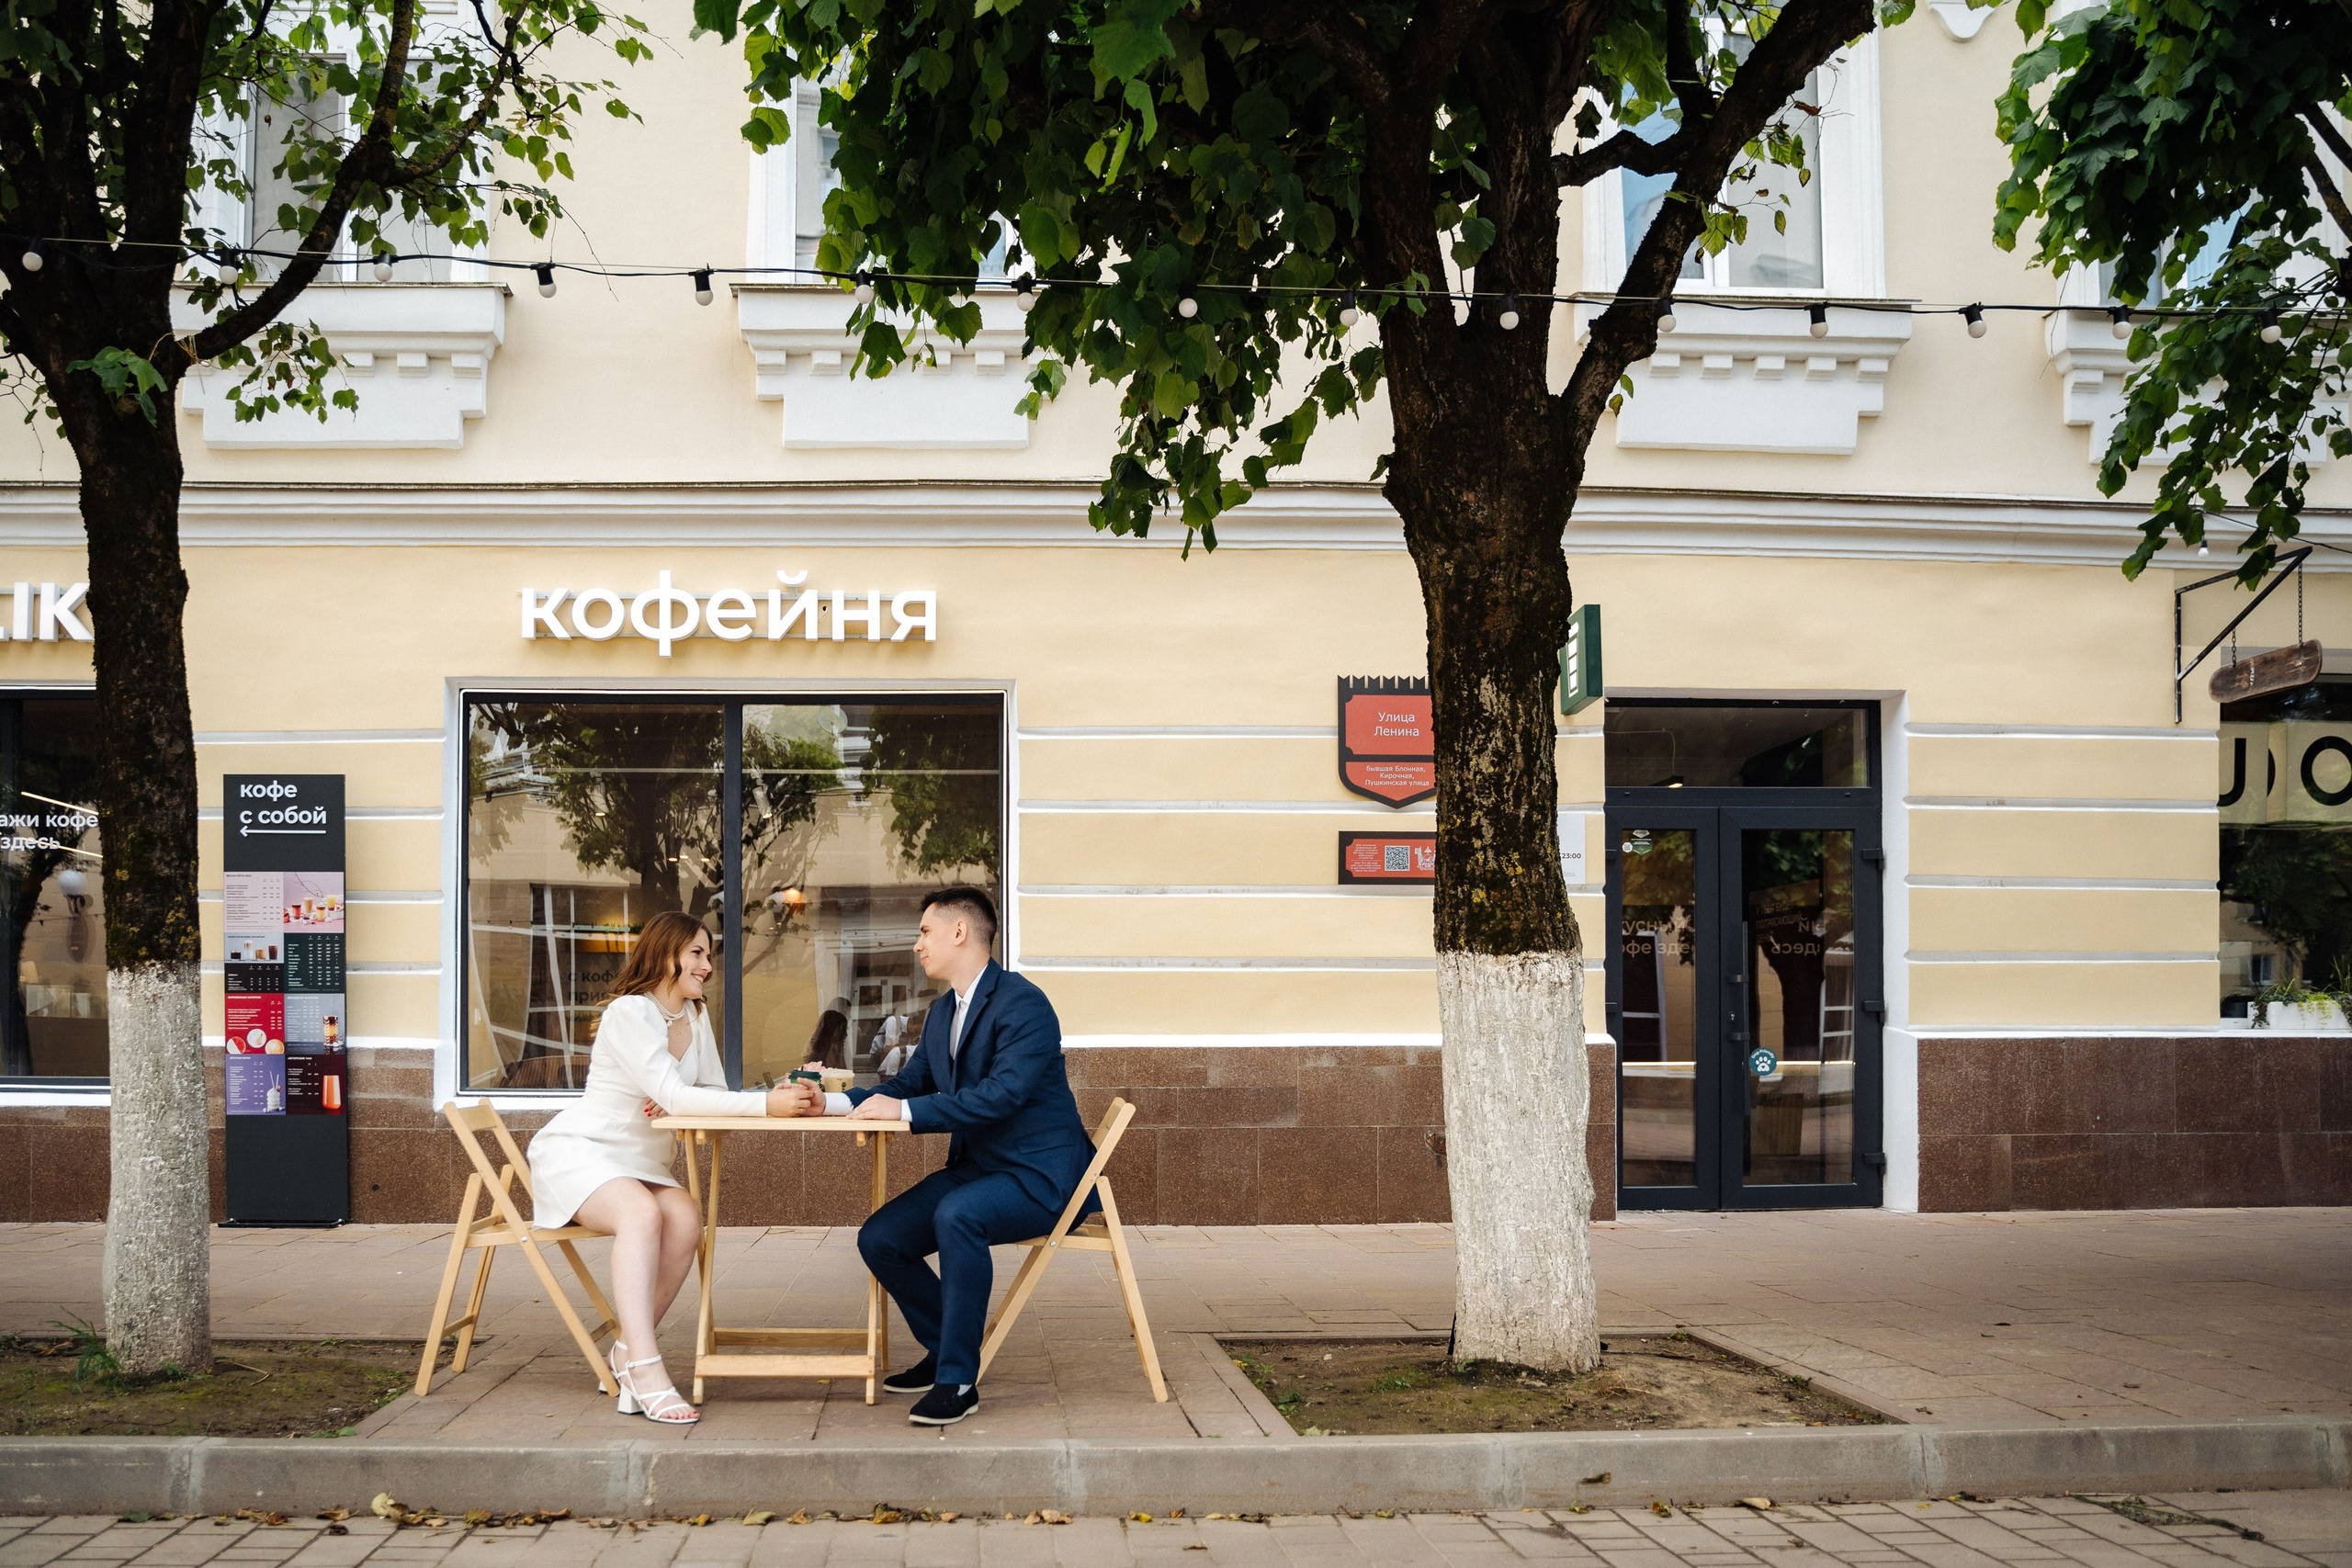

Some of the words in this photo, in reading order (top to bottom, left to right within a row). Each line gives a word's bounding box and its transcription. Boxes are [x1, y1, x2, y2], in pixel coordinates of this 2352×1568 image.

[0, 581, 95, 642] IK
[522, 570, 937, 659] кофейня
[1378, 712, 1416, 724] Улица
[1374, 726, 1420, 737] Ленина
[240, 780, 298, 802] кофе
[46, 811, 98, 831] кофе
[240, 810, 253, 824] с
[258, 806, 327, 824] собой
[1, 836, 60, 851] здесь
[1623, 918, 1687, 935] усный
[1623, 940, 1652, 957] фе
[1657, 942, 1695, 955] зде
